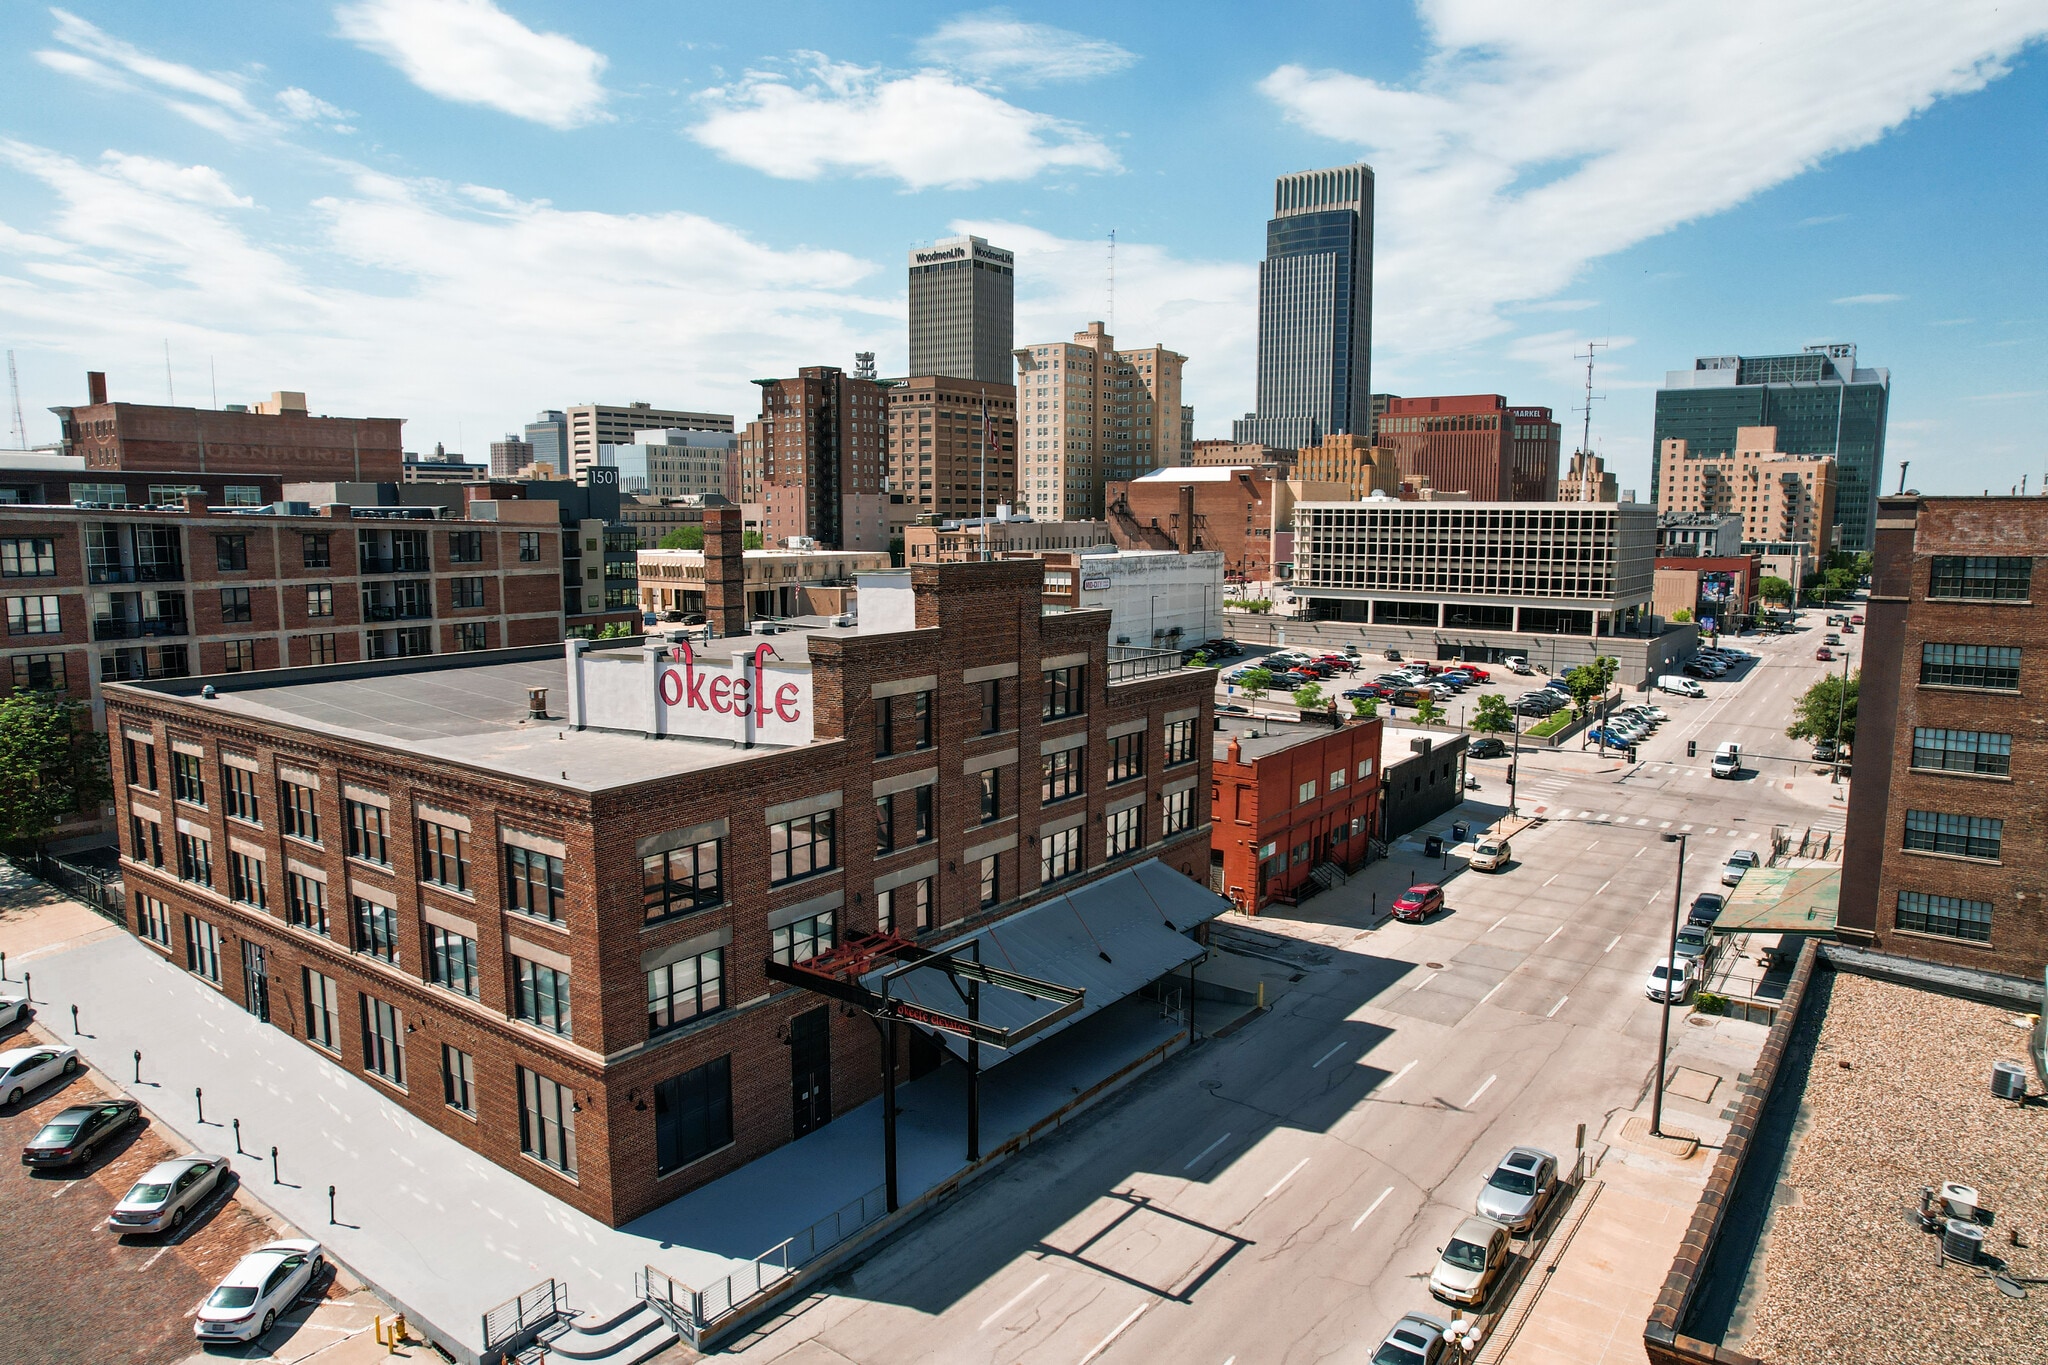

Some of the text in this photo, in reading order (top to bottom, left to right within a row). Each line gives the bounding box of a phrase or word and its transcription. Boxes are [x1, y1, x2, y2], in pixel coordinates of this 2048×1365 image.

[915, 247, 965, 264] WoodmenLife
[1513, 410, 1541, 418] MARKEL
[591, 470, 618, 484] 1501
